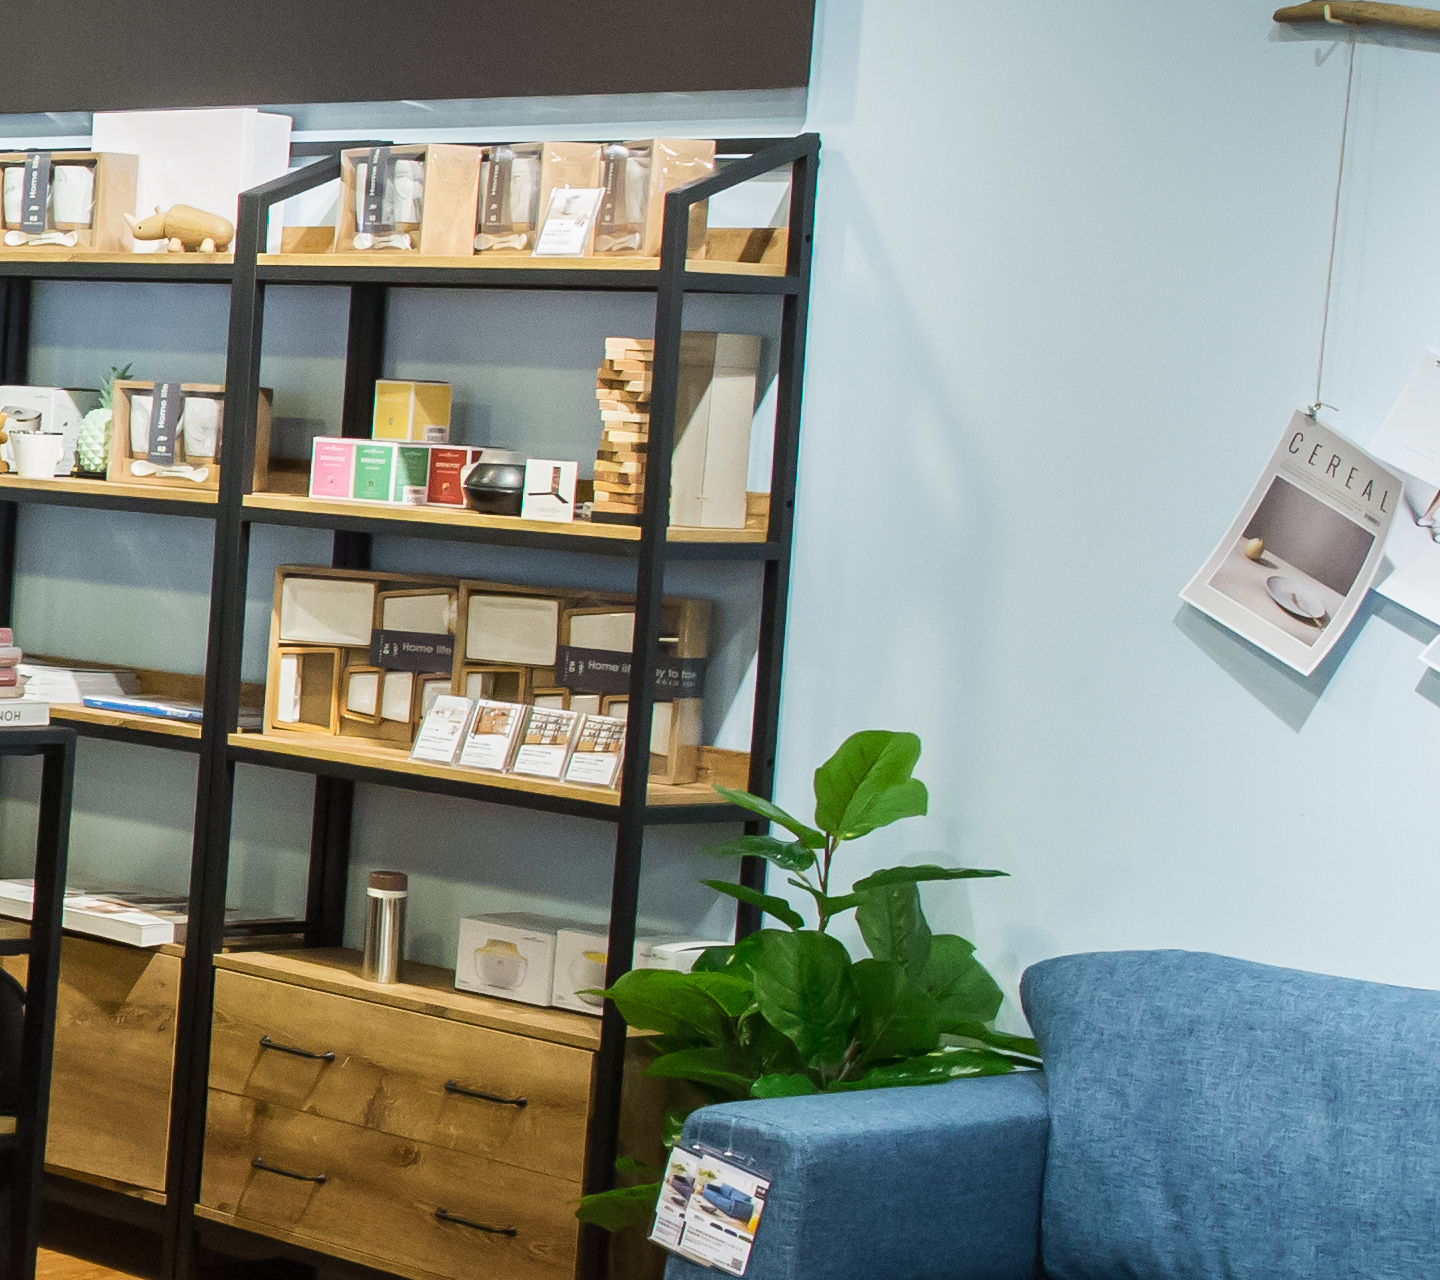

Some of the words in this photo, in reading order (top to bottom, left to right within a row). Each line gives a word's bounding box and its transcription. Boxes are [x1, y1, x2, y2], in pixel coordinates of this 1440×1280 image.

[1288, 431, 1389, 515] CEREAL
[402, 642, 434, 654] Home
[436, 644, 452, 655] life
[587, 660, 619, 672] Home
[621, 663, 631, 674] lif
